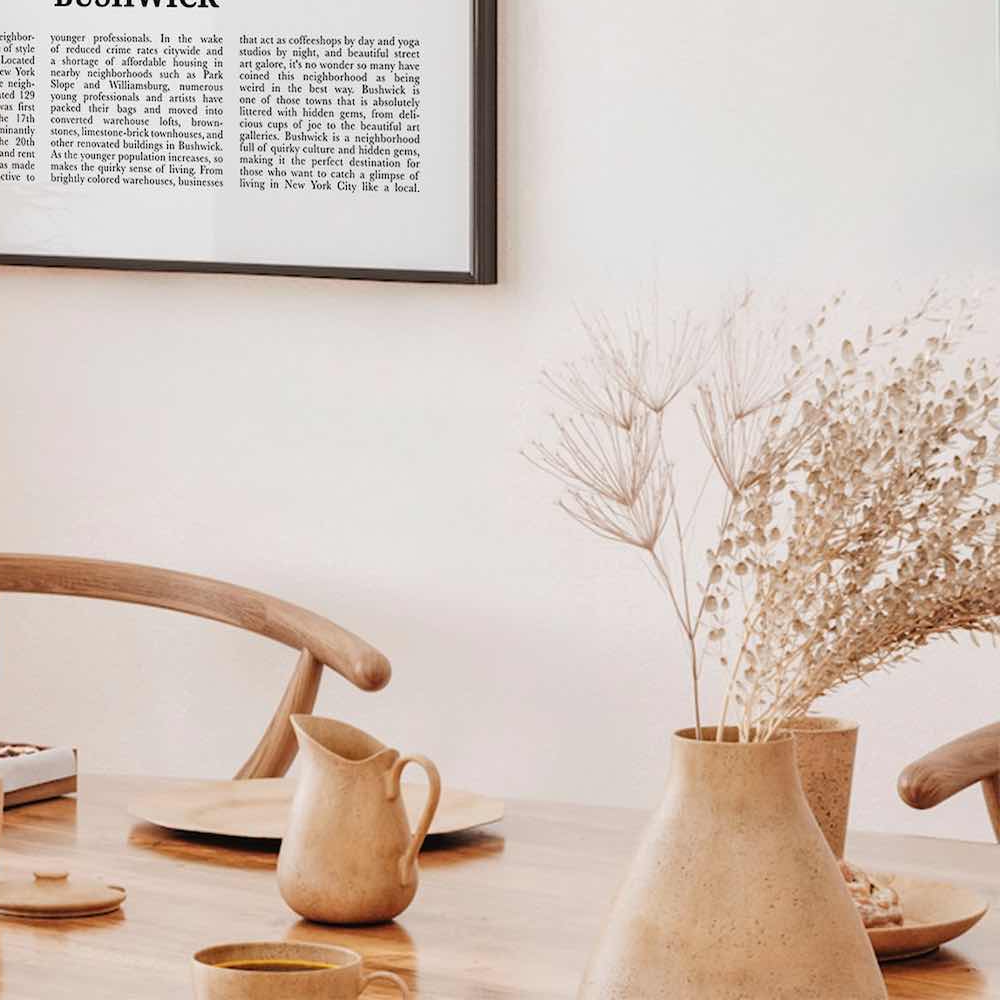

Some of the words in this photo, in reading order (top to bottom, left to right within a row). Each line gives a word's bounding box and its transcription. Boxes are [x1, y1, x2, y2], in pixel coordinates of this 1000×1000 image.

[50, 35, 85, 45] younger
[93, 32, 153, 46] professionals.
[160, 33, 170, 43] In
[178, 33, 193, 43] the
[200, 33, 224, 44] wake
[240, 34, 258, 45] that
[260, 36, 274, 45] act
[276, 37, 286, 45] as
[288, 35, 342, 48] coffeeshops
[344, 36, 356, 48] by
[358, 36, 375, 48] day
[377, 36, 396, 46] and
[398, 39, 420, 49] yoga
[3, 42, 12, 52] of
[15, 42, 36, 55] style
[50, 44, 60, 54] of
[66, 44, 101, 54] reduced
[106, 44, 132, 55] crime
[136, 46, 158, 55] rates
[163, 45, 201, 58] citywide
[206, 45, 224, 56] and
[239, 46, 272, 57] studios
[276, 47, 288, 60] by
[292, 47, 320, 60] night,
[324, 47, 342, 58] and
[348, 48, 389, 58] beautiful
[394, 49, 420, 58] street
[0, 54, 36, 64] Located
[50, 67, 81, 80] nearby
[87, 68, 153, 81] neighborhoods
[160, 69, 180, 79] such
[186, 71, 196, 79] as
[203, 69, 224, 79] Park
[239, 70, 270, 81] coined
[278, 71, 295, 81] this
[303, 71, 368, 85] neighborhood
[394, 73, 420, 85] being
[50, 79, 76, 92] Slope
[83, 79, 101, 90] and
[109, 80, 171, 93] Williamsburg,
[179, 83, 224, 91] numerous
[20, 89, 36, 99] 129
[50, 93, 77, 104] young
[83, 91, 140, 104] professionals
[146, 92, 163, 102] and
[169, 92, 196, 103] artists
[202, 93, 223, 103] have
[18, 101, 35, 111] first
[50, 102, 81, 115] packed
[88, 103, 109, 113] their
[117, 104, 137, 116] bags
[144, 104, 161, 114] and
[168, 104, 198, 115] moved
[205, 105, 224, 115] into
[239, 106, 273, 117] littered
[277, 107, 298, 118] with
[302, 108, 335, 118] hidden
[340, 111, 366, 121] gems,
[371, 109, 394, 119] from
[398, 109, 420, 120] deli-
[50, 127, 80, 138] stones,
[82, 126, 150, 138] limestone-brick
[150, 128, 205, 140] townhouses,
[206, 129, 224, 139] and
[239, 130, 280, 144] galleries.
[285, 131, 328, 142] Bushwick
[332, 132, 340, 142] is
[344, 135, 350, 143] a
[354, 133, 421, 146] neighborhood
[15, 136, 36, 146] 20th
[50, 138, 74, 148] other
[77, 138, 120, 149] renovated
[123, 139, 163, 152] buildings
[166, 140, 175, 150] in
[178, 140, 223, 151] Bushwick.
[240, 142, 255, 153] full
[257, 143, 266, 153] of
[270, 143, 300, 156] quirky
[302, 144, 335, 154] culture
[338, 144, 356, 155] and
[358, 145, 391, 156] hidden
[393, 148, 420, 159] gems,
[11, 159, 36, 170] made
[26, 172, 36, 181] to
[50, 172, 85, 186] brightly
[87, 174, 120, 184] colored
[122, 174, 176, 187] warehouses,
[178, 176, 224, 187] businesses
[240, 178, 265, 192] living
[270, 179, 279, 190] in
[284, 180, 306, 190] New
[312, 180, 332, 191] York
[337, 181, 357, 194] City
[362, 182, 378, 192] like
[384, 184, 390, 192] a
[394, 182, 420, 193] local.
